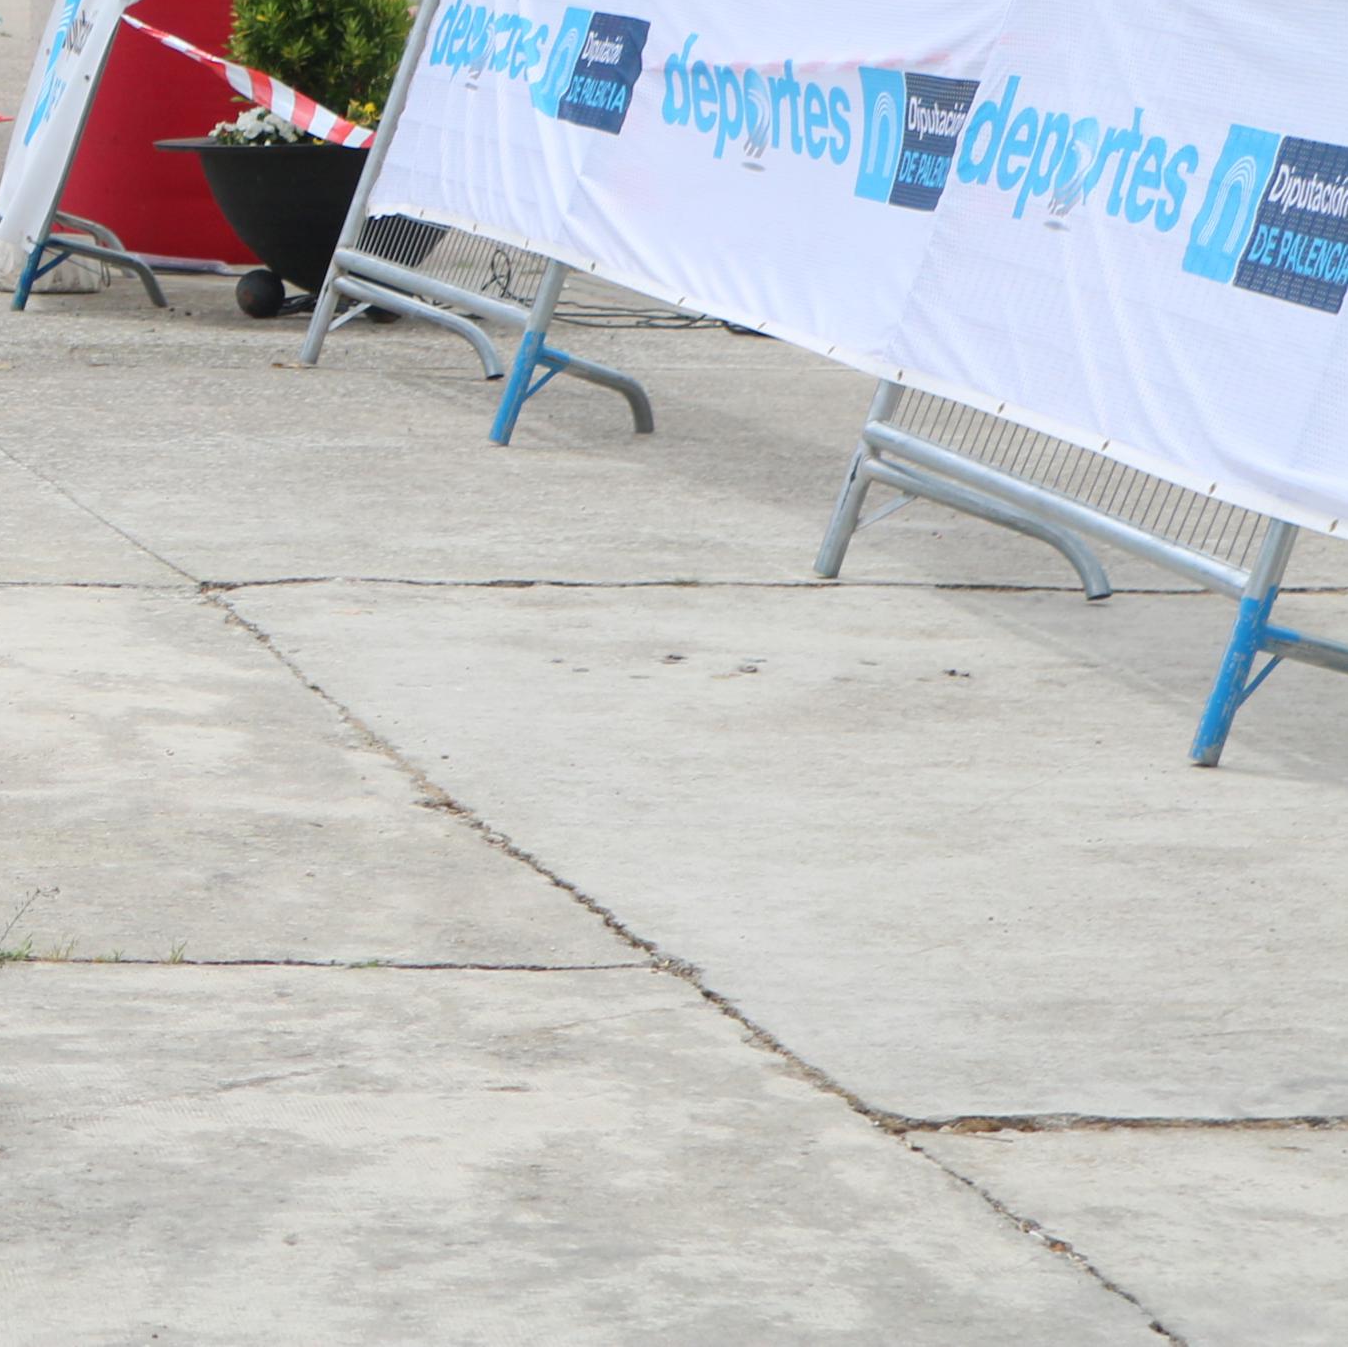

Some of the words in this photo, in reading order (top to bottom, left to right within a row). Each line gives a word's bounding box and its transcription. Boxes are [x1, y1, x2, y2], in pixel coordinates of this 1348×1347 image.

[662, 33, 851, 165] deportes
[898, 151, 919, 184] DE
[956, 75, 1199, 232] deportes
[1247, 224, 1280, 266] DE
